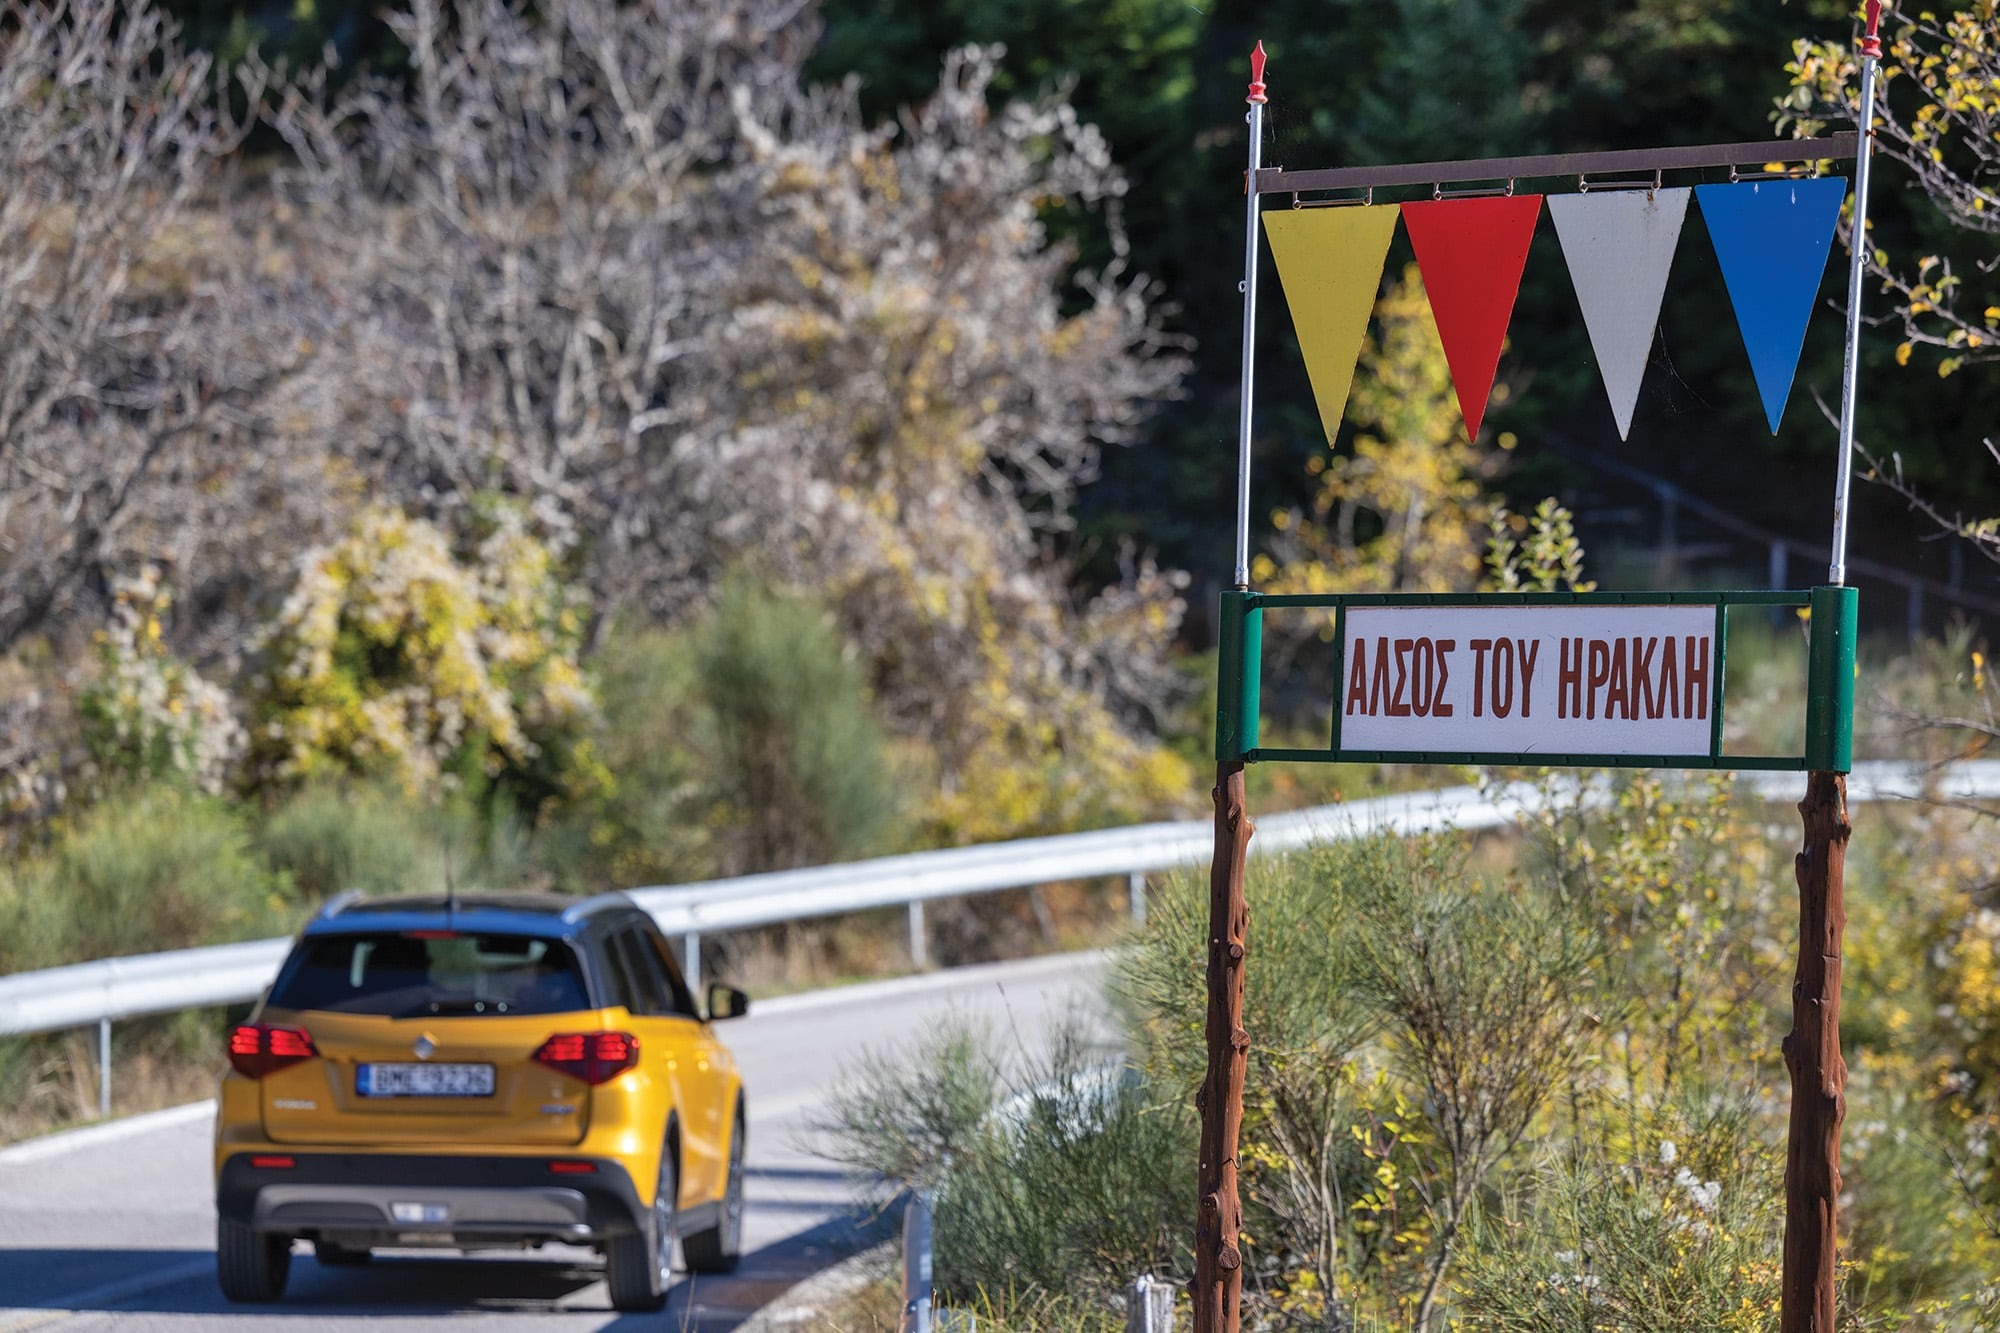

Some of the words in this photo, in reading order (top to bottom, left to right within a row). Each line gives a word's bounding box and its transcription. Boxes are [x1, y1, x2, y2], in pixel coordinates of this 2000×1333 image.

[1346, 637, 1456, 718] ΑΛΣΟΣ
[1470, 637, 1540, 719] ΤΟΥ
[1558, 636, 1709, 720] ΗΡΑΚΛΗ
